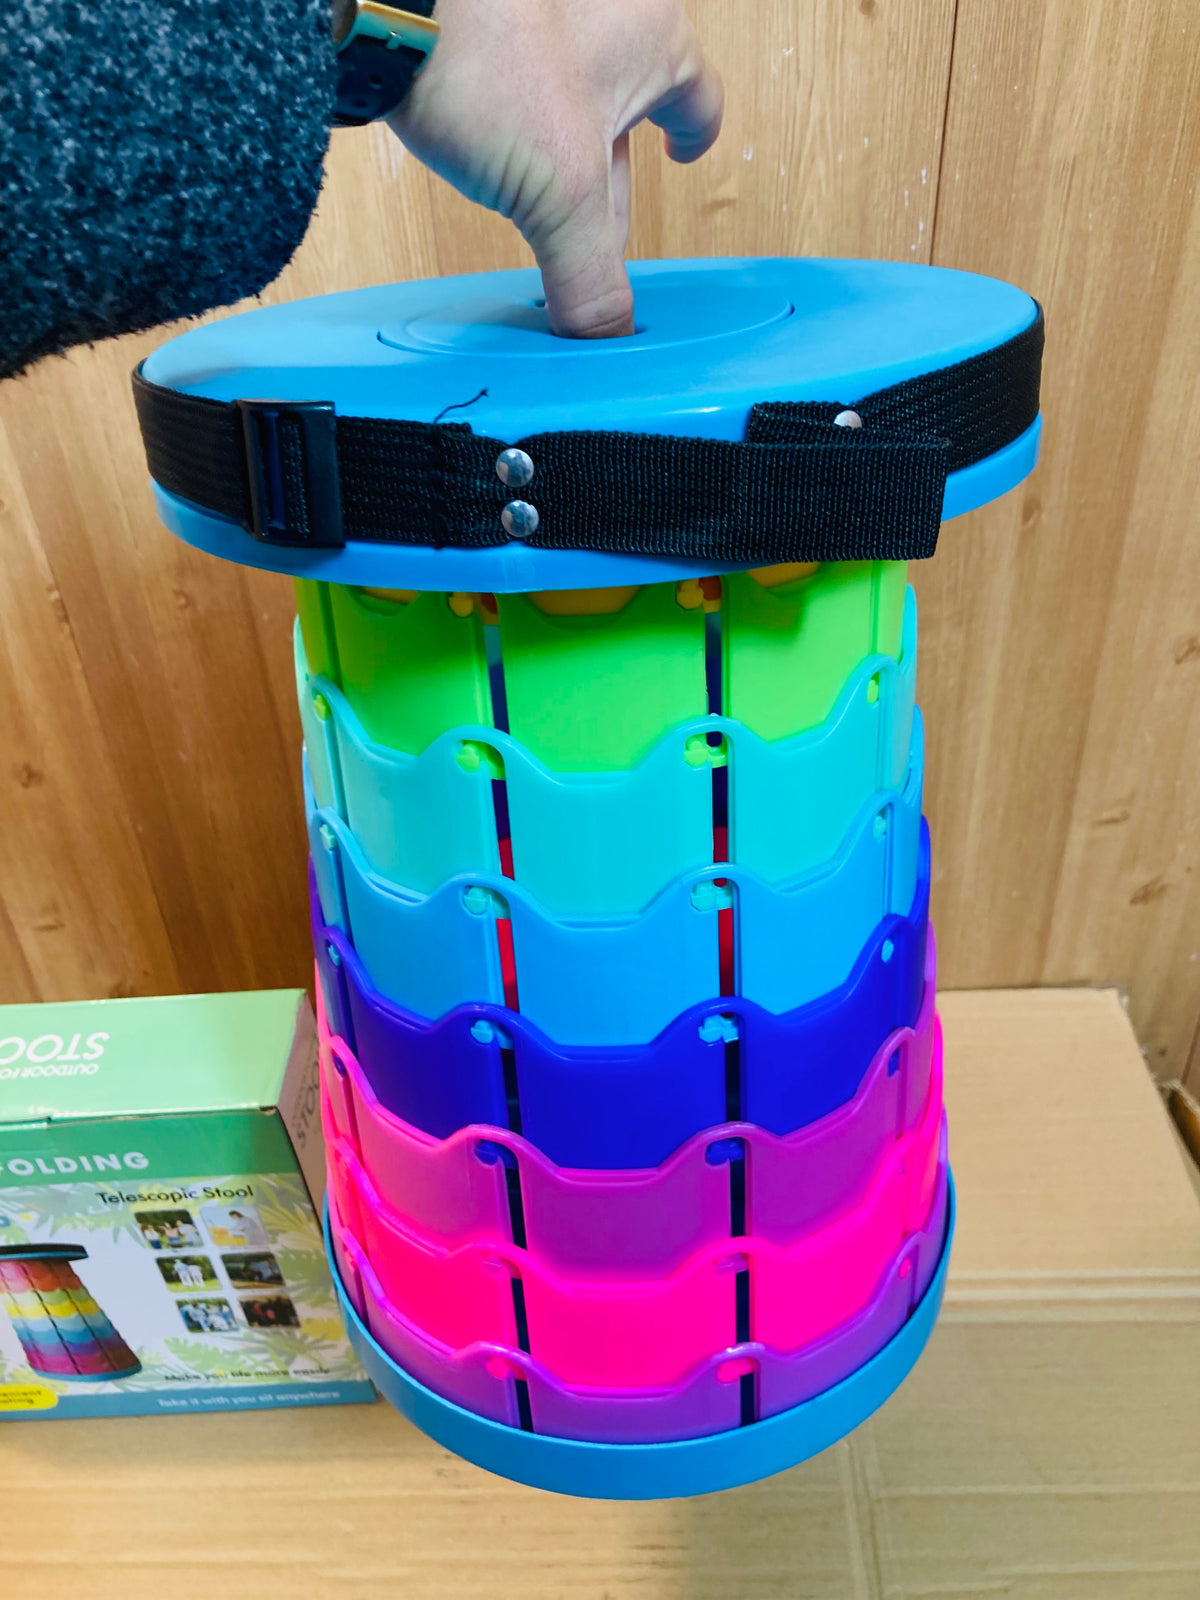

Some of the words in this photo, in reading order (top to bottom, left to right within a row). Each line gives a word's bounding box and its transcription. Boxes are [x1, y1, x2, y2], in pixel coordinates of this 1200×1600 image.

[21, 1063, 99, 1079] OUTDOOR
[0, 1151, 150, 1176] OLDING
[95, 1187, 200, 1204] Telescopic
[202, 1184, 254, 1199] Stool
[254, 1369, 290, 1378] more
[201, 1395, 231, 1406] with
[231, 1395, 257, 1406] you
[275, 1389, 341, 1403] anywhere
